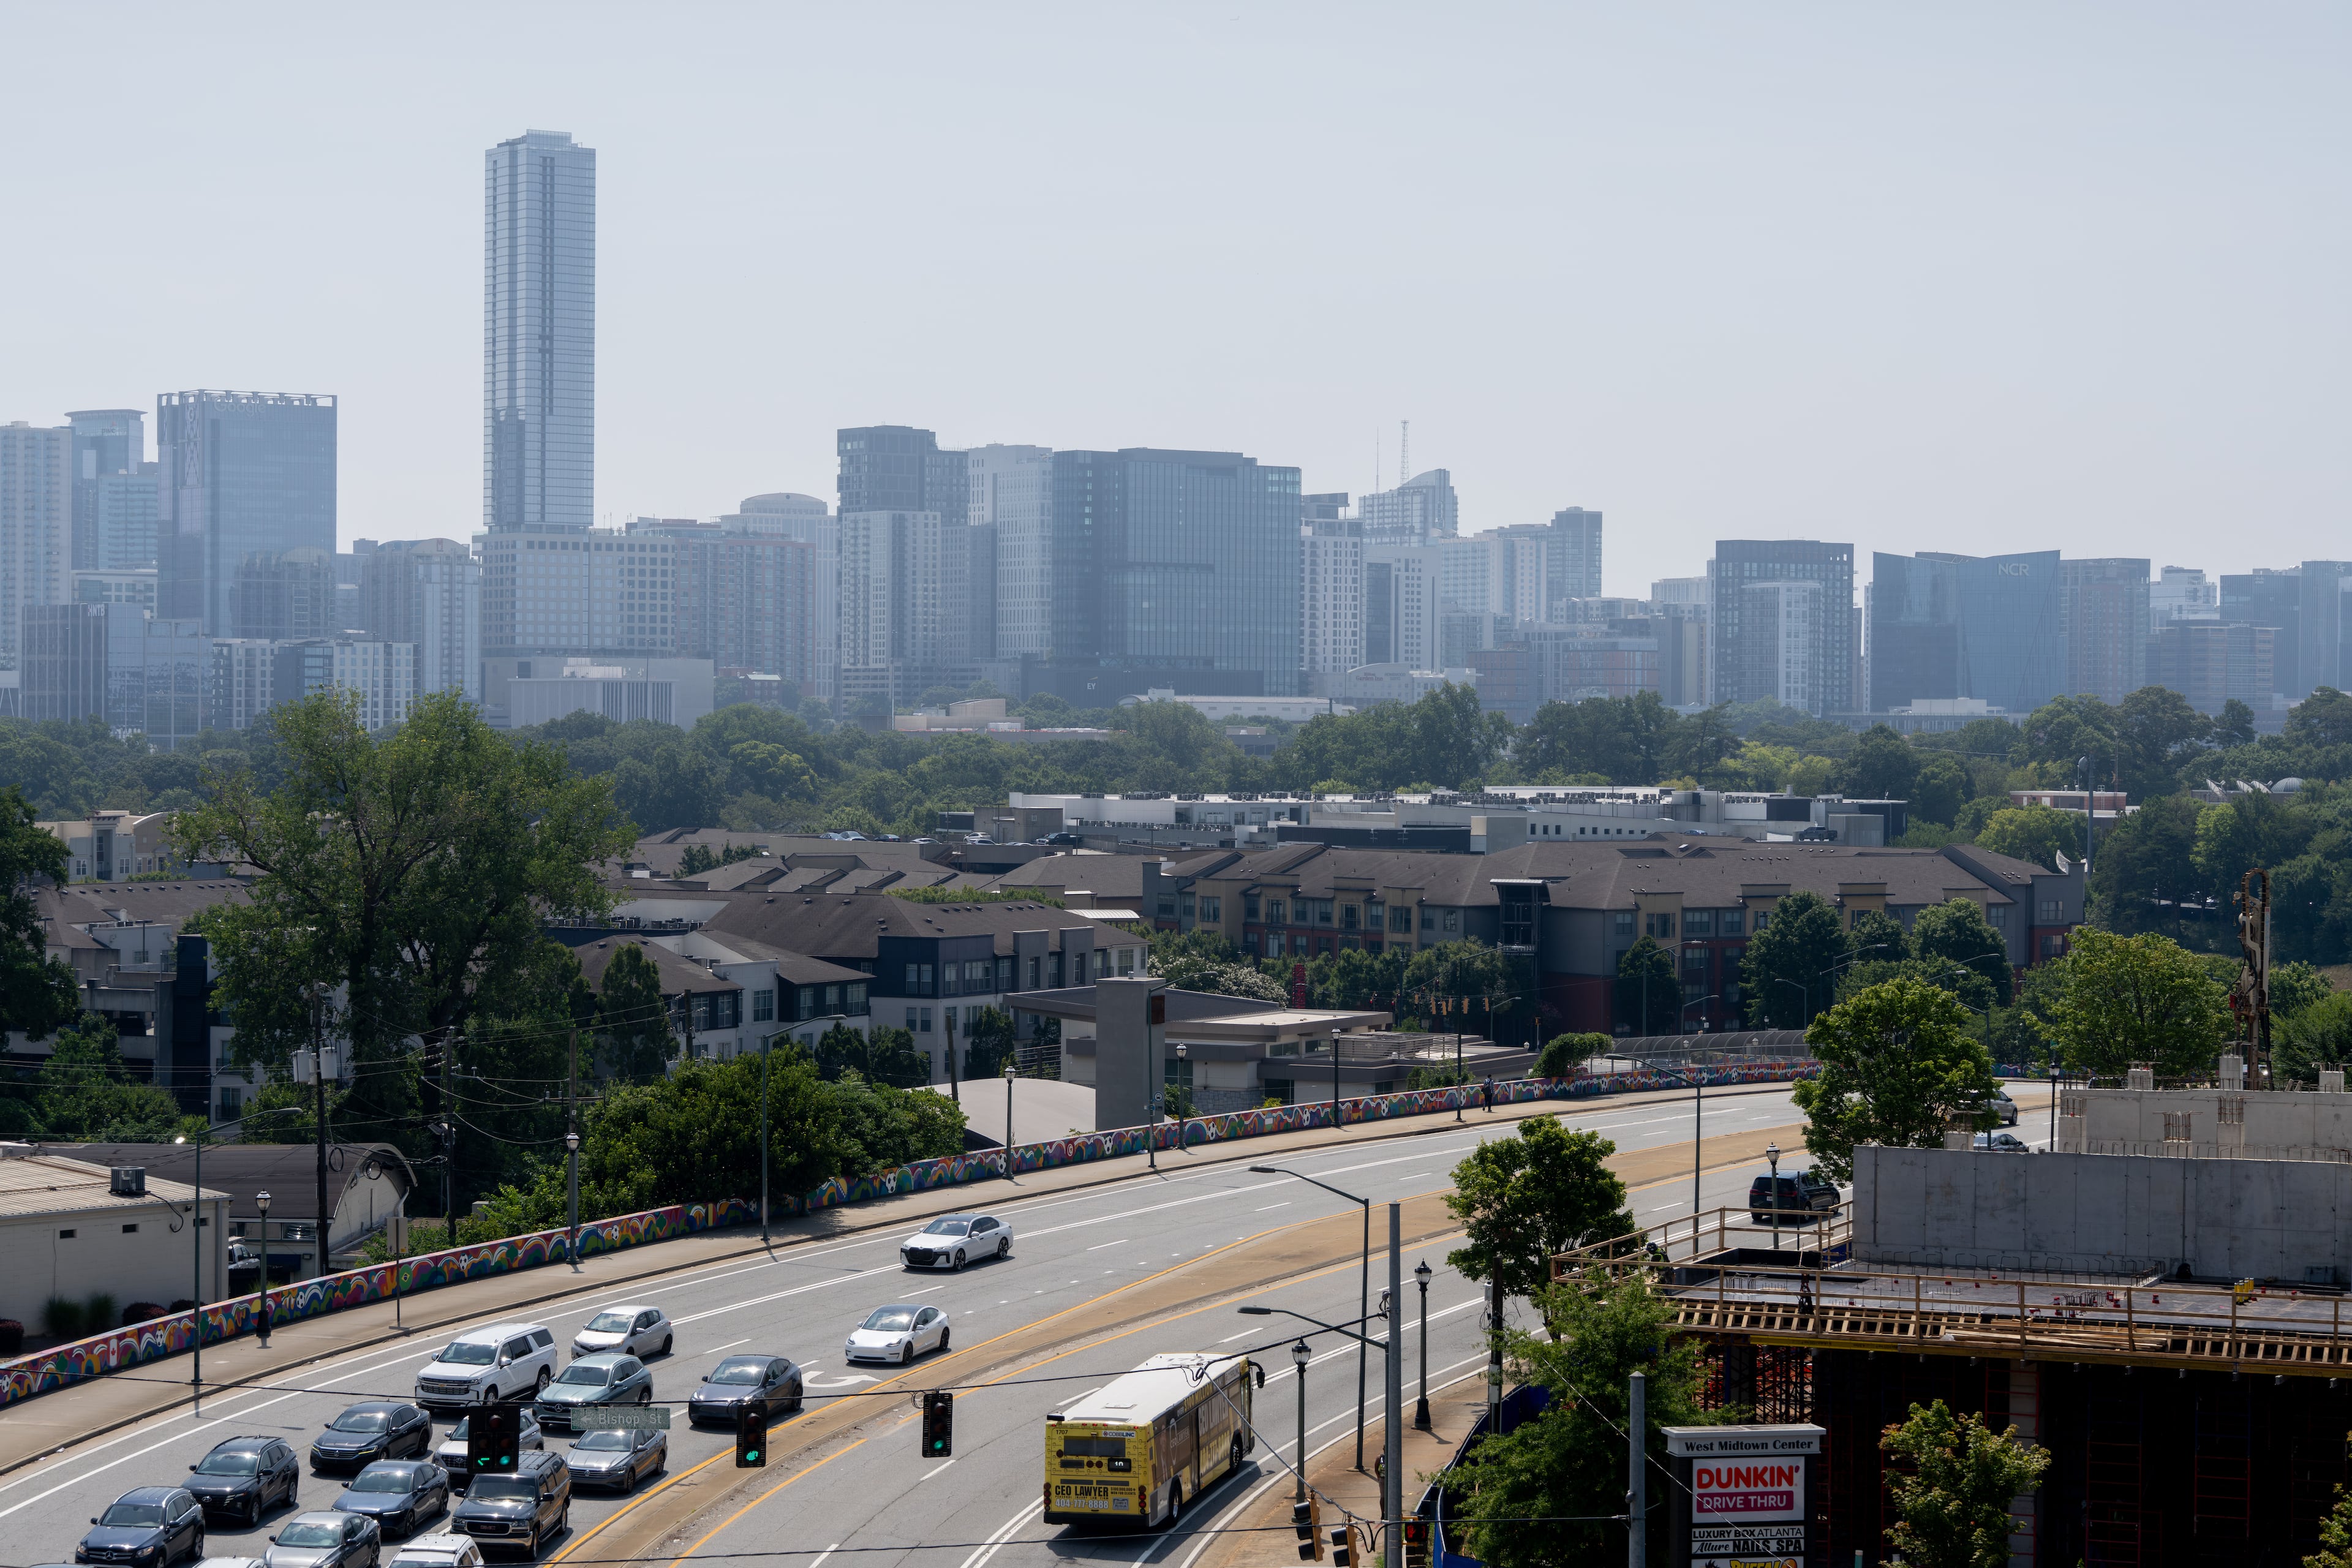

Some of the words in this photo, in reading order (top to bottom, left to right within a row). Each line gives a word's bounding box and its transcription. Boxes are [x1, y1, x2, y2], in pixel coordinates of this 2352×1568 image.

[214, 398, 267, 417] Google
[1998, 563, 2029, 576] NCR
[88, 603, 105, 617] HNTB
[1195, 1381, 1213, 1404] MILLION
[598, 1414, 640, 1427] Bishop
[649, 1414, 662, 1425] St
[1684, 1441, 1714, 1452] West
[1718, 1440, 1769, 1451] Midtown
[1773, 1439, 1814, 1450] Center
[1697, 1464, 1800, 1490] DUNKIN'
[1055, 1485, 1071, 1496] CEO
[1075, 1486, 1109, 1497] LAWYER
[1055, 1498, 1109, 1509] 404-777-8888
[1703, 1496, 1744, 1510] DRIVE
[1748, 1494, 1787, 1508] THRU
[1693, 1529, 1733, 1539] LUXURY
[1734, 1529, 1756, 1538] BOX
[1757, 1527, 1803, 1537] ATLANTA
[1694, 1541, 1730, 1554] Allure
[1733, 1540, 1771, 1553] NAILS
[1776, 1539, 1803, 1551] SPA
